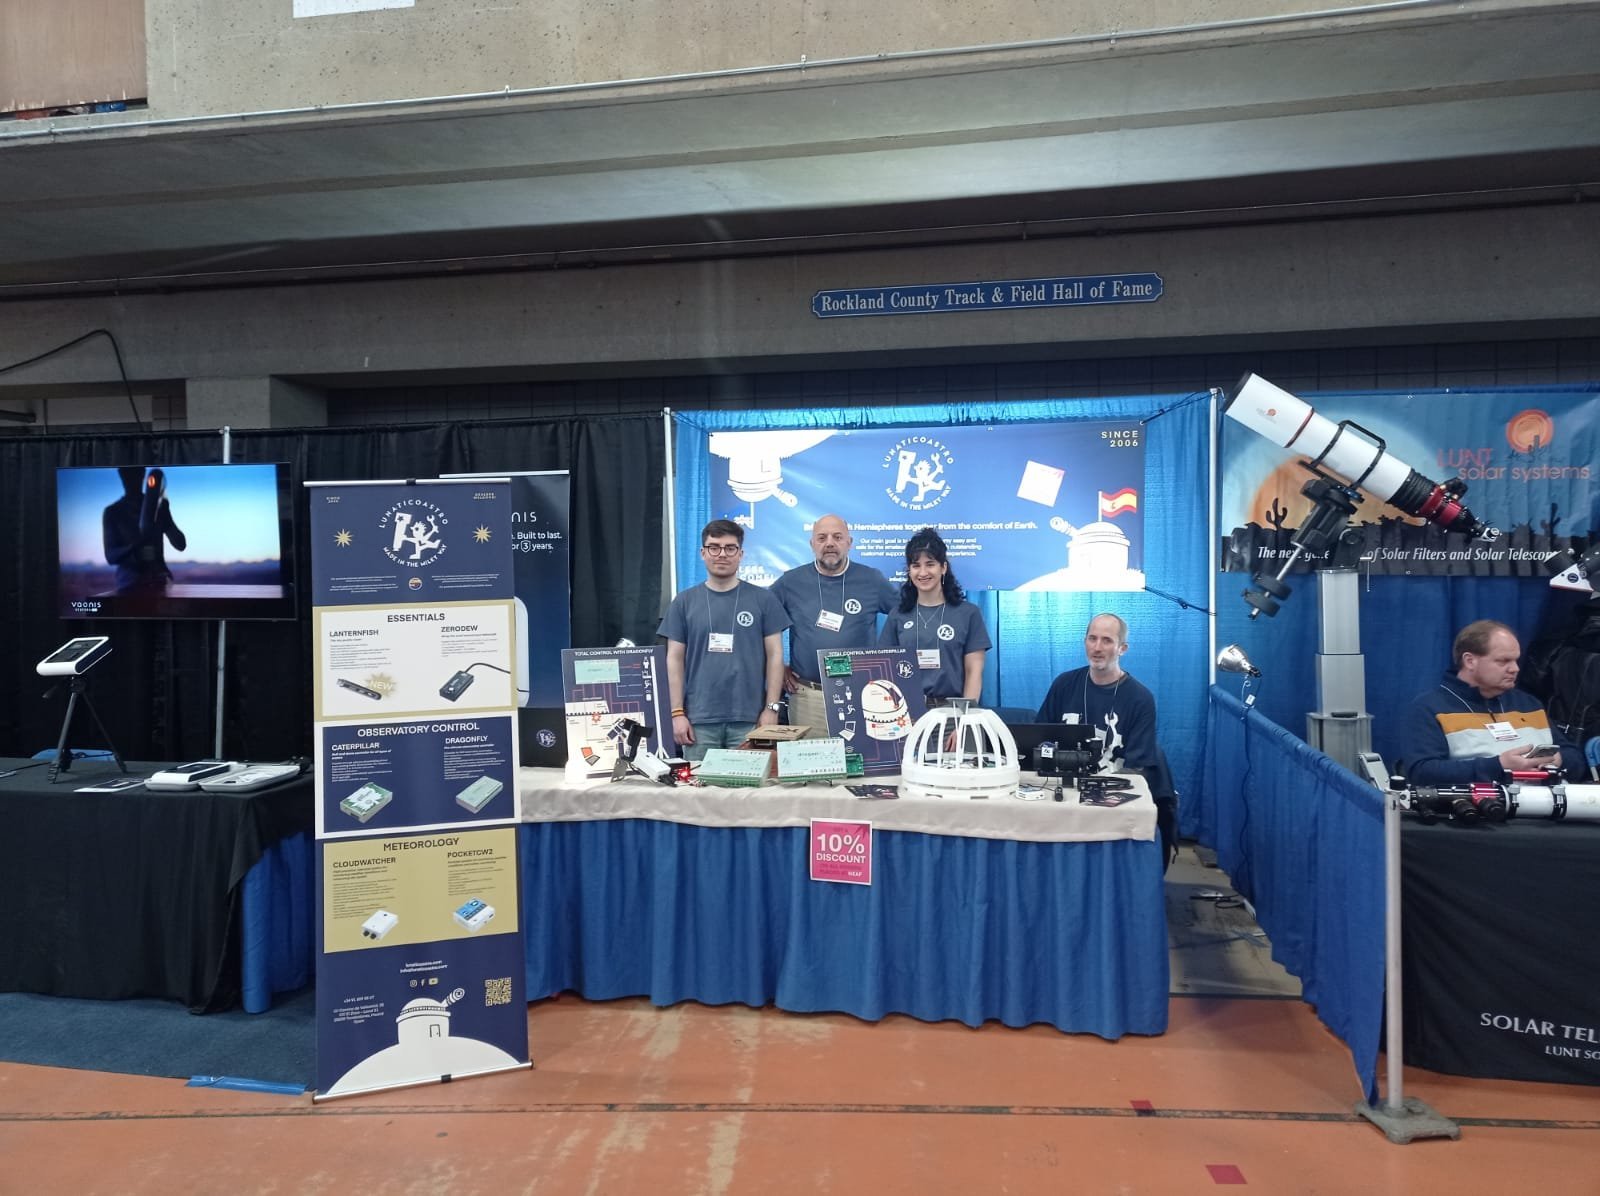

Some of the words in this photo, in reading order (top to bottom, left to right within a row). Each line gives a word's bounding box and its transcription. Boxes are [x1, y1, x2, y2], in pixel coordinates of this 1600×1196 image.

[821, 292, 885, 312] Rockland
[890, 290, 940, 309] County
[944, 287, 986, 305] Track
[991, 287, 1004, 303] &
[1011, 284, 1047, 302] Field
[1052, 282, 1084, 300] Hall
[1089, 281, 1105, 298] of
[1111, 279, 1154, 297] Fame
[1101, 430, 1139, 439] SINCE
[1110, 439, 1139, 448] 2006
[1437, 447, 1493, 467] LUNT
[1457, 464, 1507, 481] solar
[1511, 464, 1591, 482] systems
[378, 499, 449, 529] LUNATICOASTRO
[957, 522, 972, 530] the
[516, 531, 537, 540] Built
[537, 532, 546, 540] to
[1258, 546, 1276, 559] The
[1380, 548, 1410, 561] Solar
[1412, 547, 1447, 561] Filters
[1449, 547, 1472, 561] and
[1473, 547, 1505, 561] Solar
[406, 560, 420, 568] THE
[387, 612, 446, 623] ESSENTIALS
[329, 629, 379, 637] LANTERNFISH
[440, 624, 479, 632] ZERODEW
[357, 724, 430, 738] OBSERVATORY
[431, 722, 480, 733] CONTROL
[445, 735, 489, 744] DRAGONFLY
[331, 742, 381, 751] CATERPILLAR
[383, 837, 460, 852] METEOROLOGY
[816, 833, 865, 854] 10%
[332, 857, 397, 869] CLOUDWATCHER
[816, 852, 867, 864] DISCOUNT
[1480, 1012, 1555, 1036] SOLAR
[1560, 1024, 1600, 1044] TEL
[1544, 1045, 1582, 1058] LUNT
